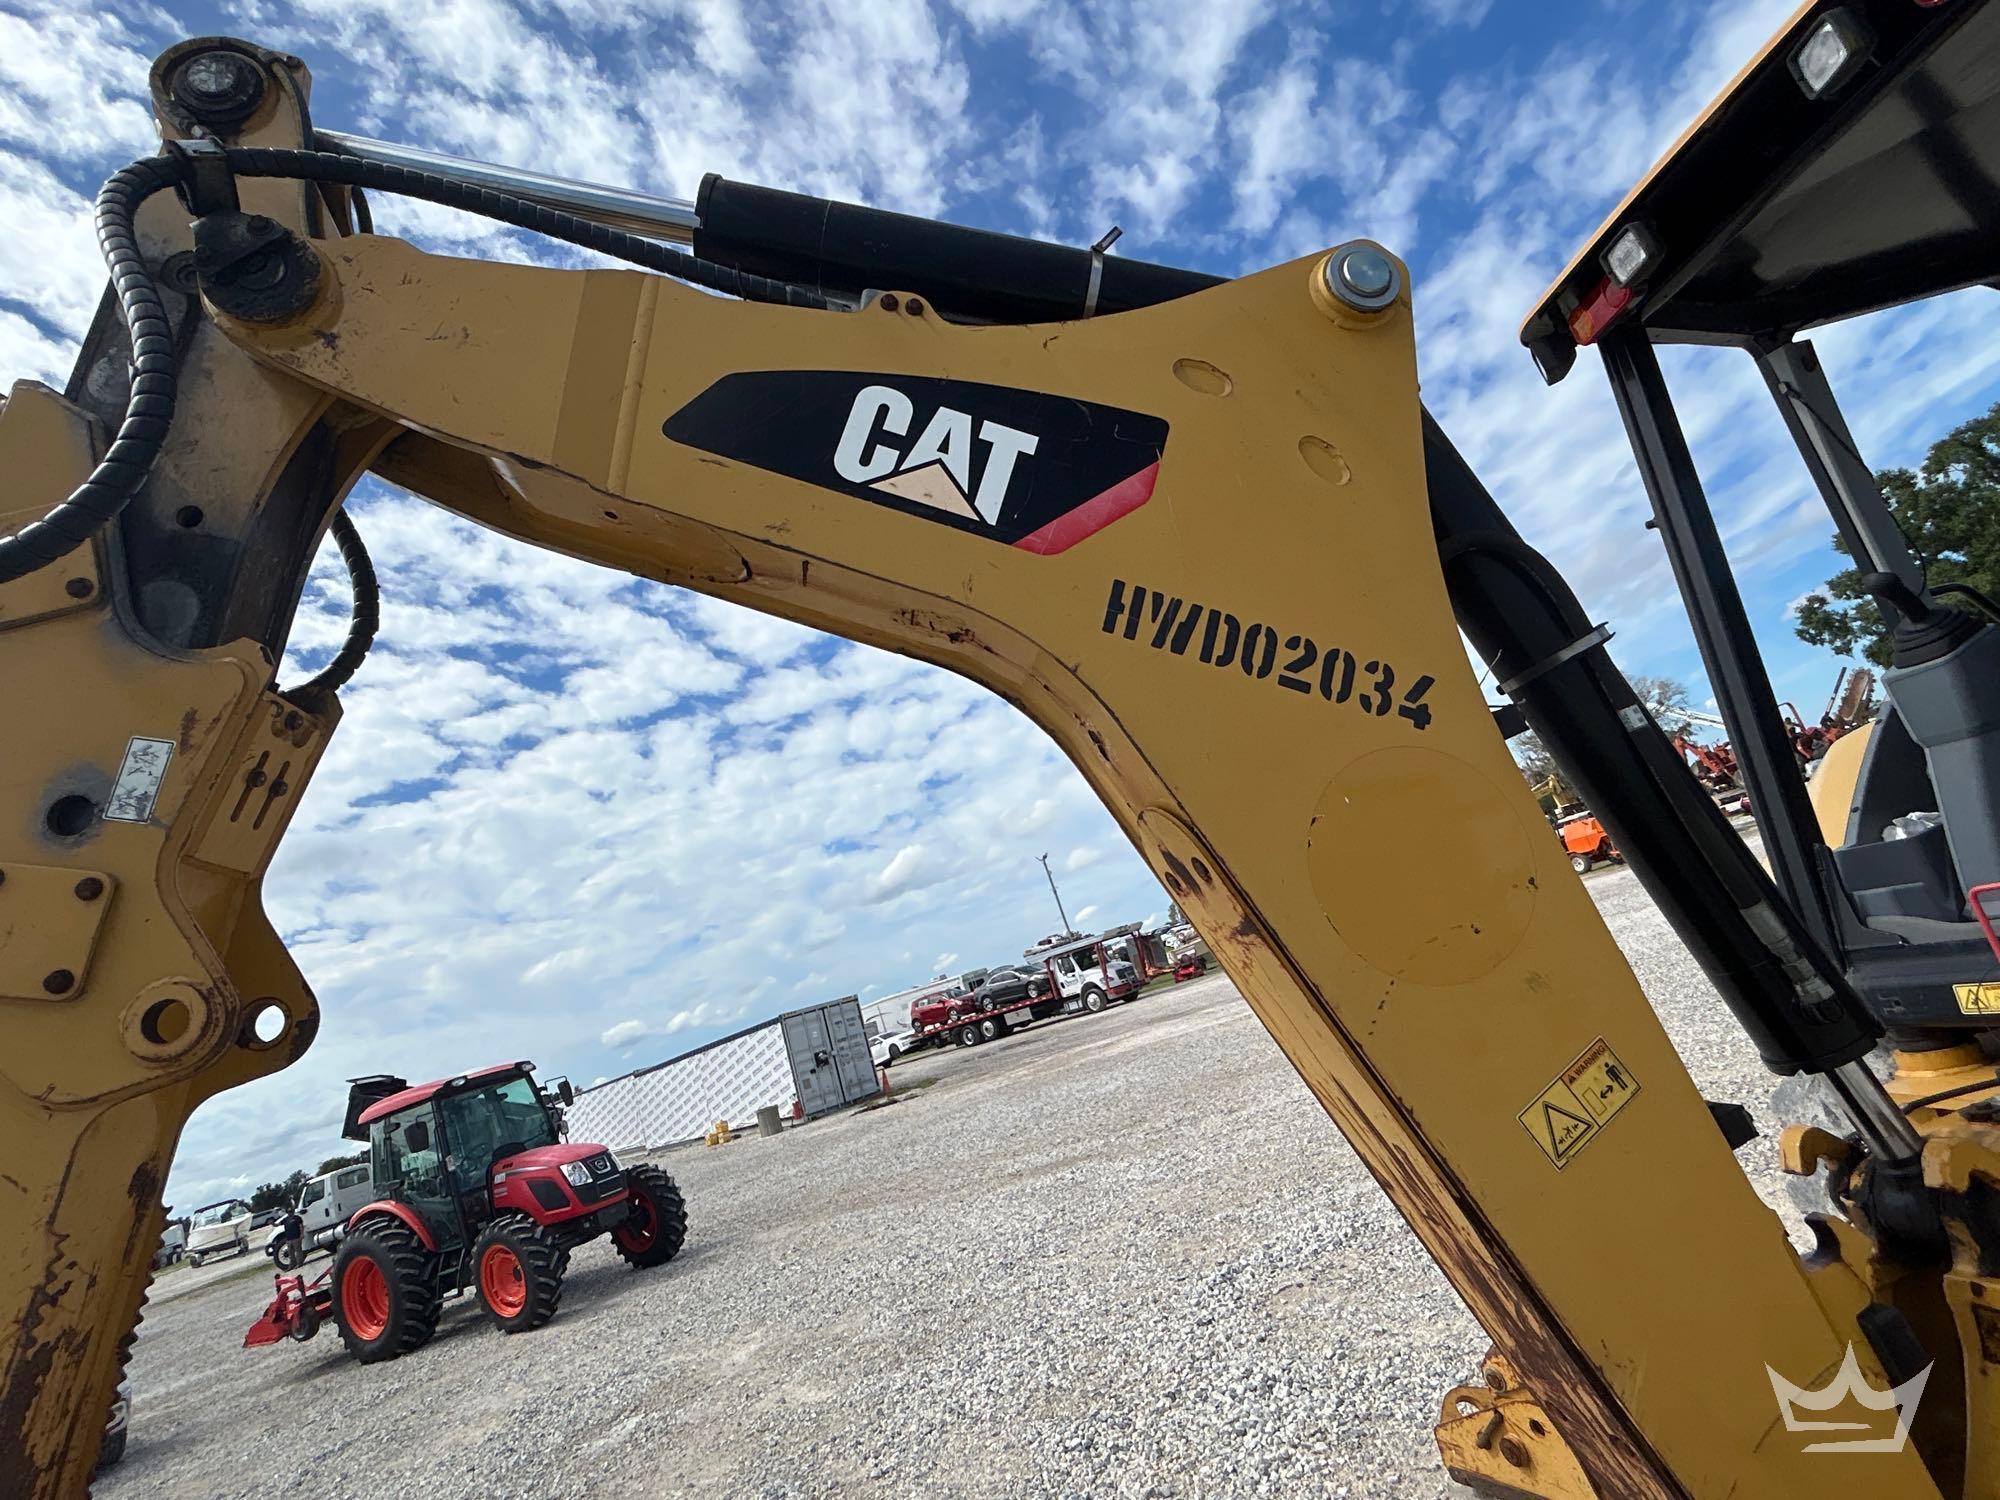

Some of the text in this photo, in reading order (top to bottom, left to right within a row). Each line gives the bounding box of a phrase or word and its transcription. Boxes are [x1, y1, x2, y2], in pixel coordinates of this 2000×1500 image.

[834, 385, 1039, 526] CAT
[1102, 579, 1435, 730] HWD02034
[1573, 1045, 1606, 1076] WARNING
